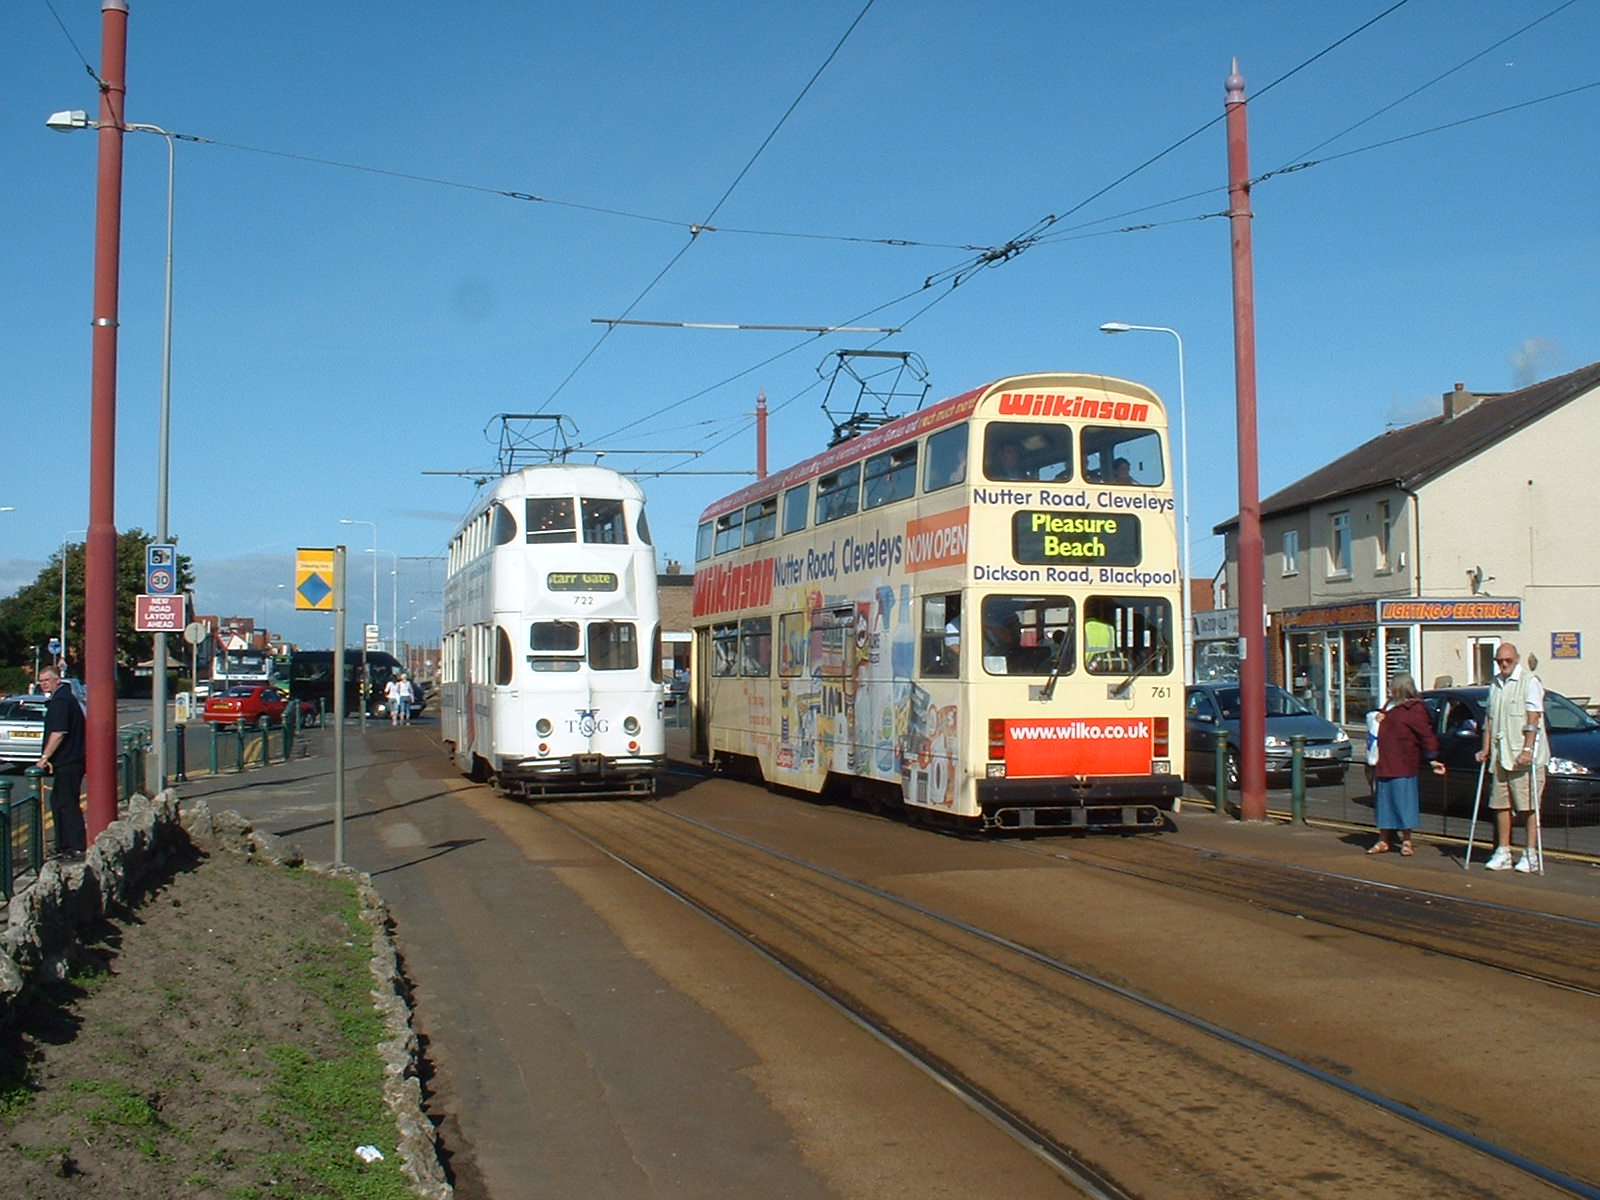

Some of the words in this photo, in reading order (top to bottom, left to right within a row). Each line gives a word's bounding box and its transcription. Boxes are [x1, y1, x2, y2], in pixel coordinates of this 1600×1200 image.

[998, 394, 1148, 422] Wilkinson
[973, 489, 1032, 505] Nutter
[1040, 490, 1091, 509] Road,
[1097, 492, 1174, 514] Cleveleys
[1031, 513, 1117, 534] Pleasure
[906, 533, 935, 565] NOW
[934, 525, 967, 559] OPEN
[1044, 536, 1106, 557] Beach
[774, 557, 804, 587] Nutter
[806, 541, 837, 582] Road,
[842, 529, 902, 576] Cleveleys
[153, 575, 169, 585] 30
[692, 557, 774, 618] Wilkinson
[973, 566, 1040, 582] Dickson
[1046, 567, 1094, 585] Road,
[1099, 569, 1176, 588] Blackpool
[574, 596, 594, 605] 722
[1383, 603, 1441, 619] LIGHTING
[1453, 603, 1520, 619] ELECTRICAL
[1151, 687, 1171, 698] 761
[1010, 722, 1149, 740] www.wilko.co.uk
